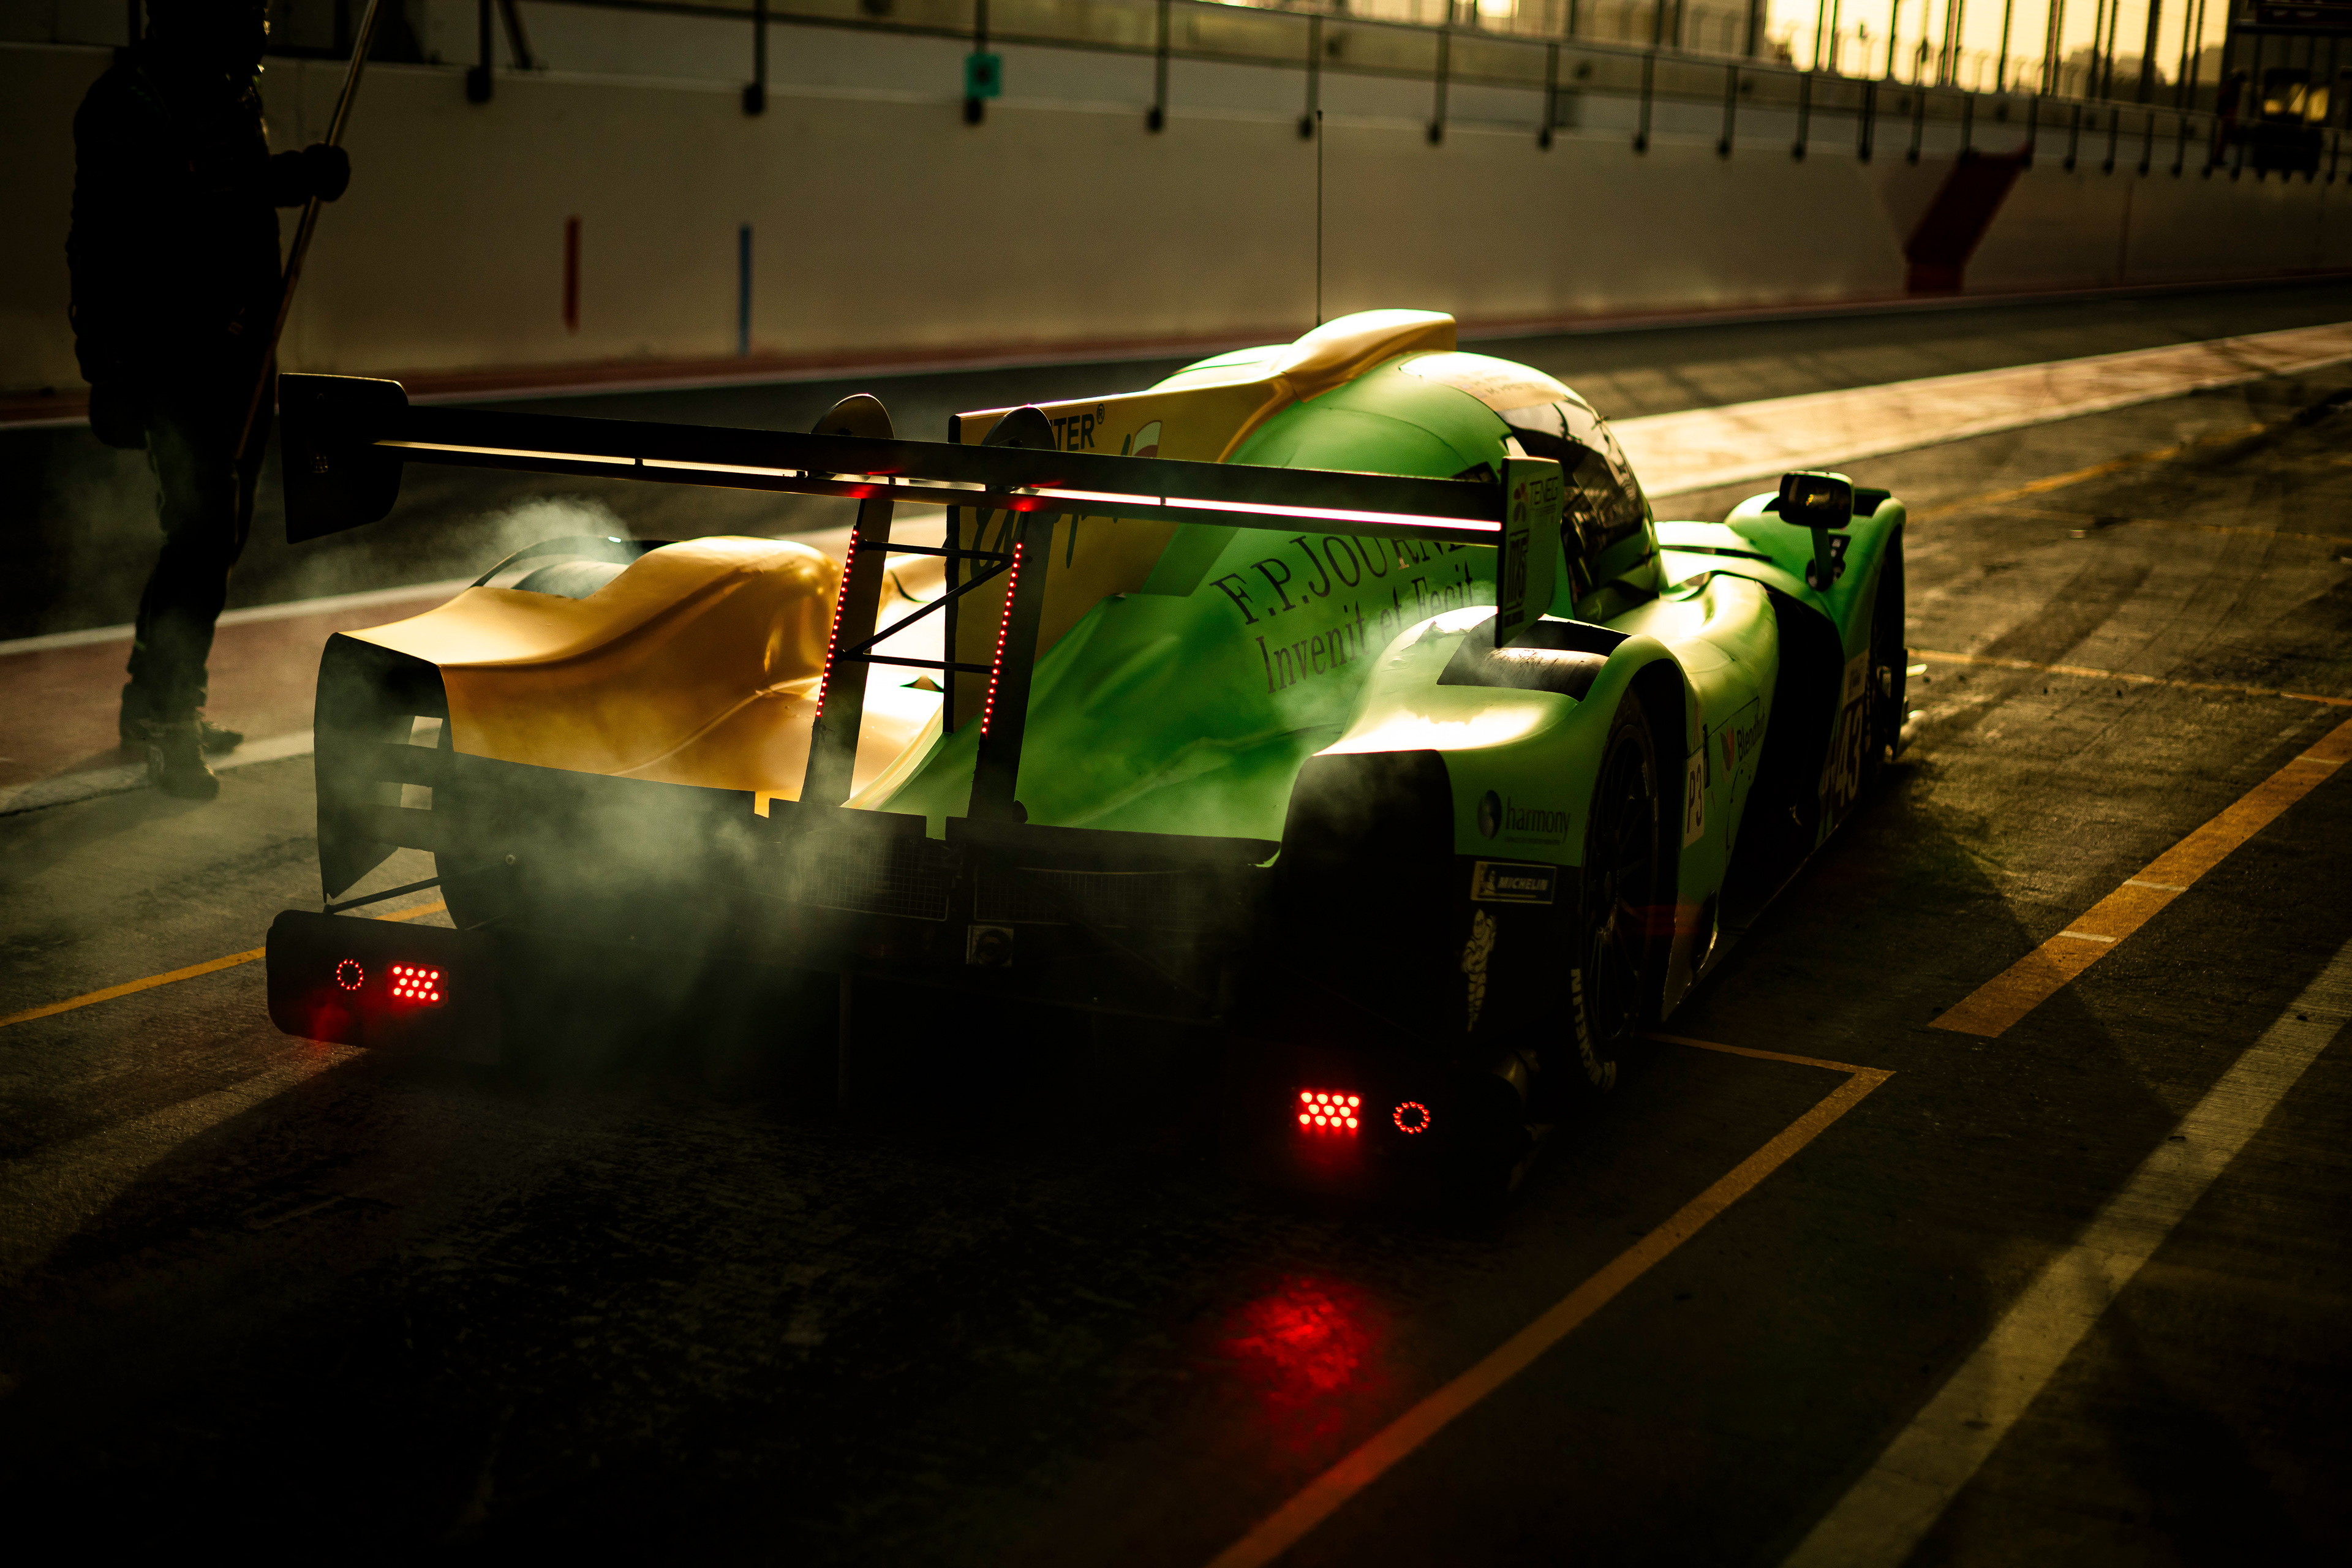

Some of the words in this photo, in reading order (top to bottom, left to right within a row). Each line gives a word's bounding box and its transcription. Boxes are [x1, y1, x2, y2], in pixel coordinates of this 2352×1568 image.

[1255, 600, 1370, 695] Invenit
[1379, 586, 1403, 646] et
[1411, 560, 1473, 620] Fecit
[1506, 796, 1571, 843] harmony
[1686, 763, 1703, 834] P3
[1498, 876, 1549, 891] MICHELIN
